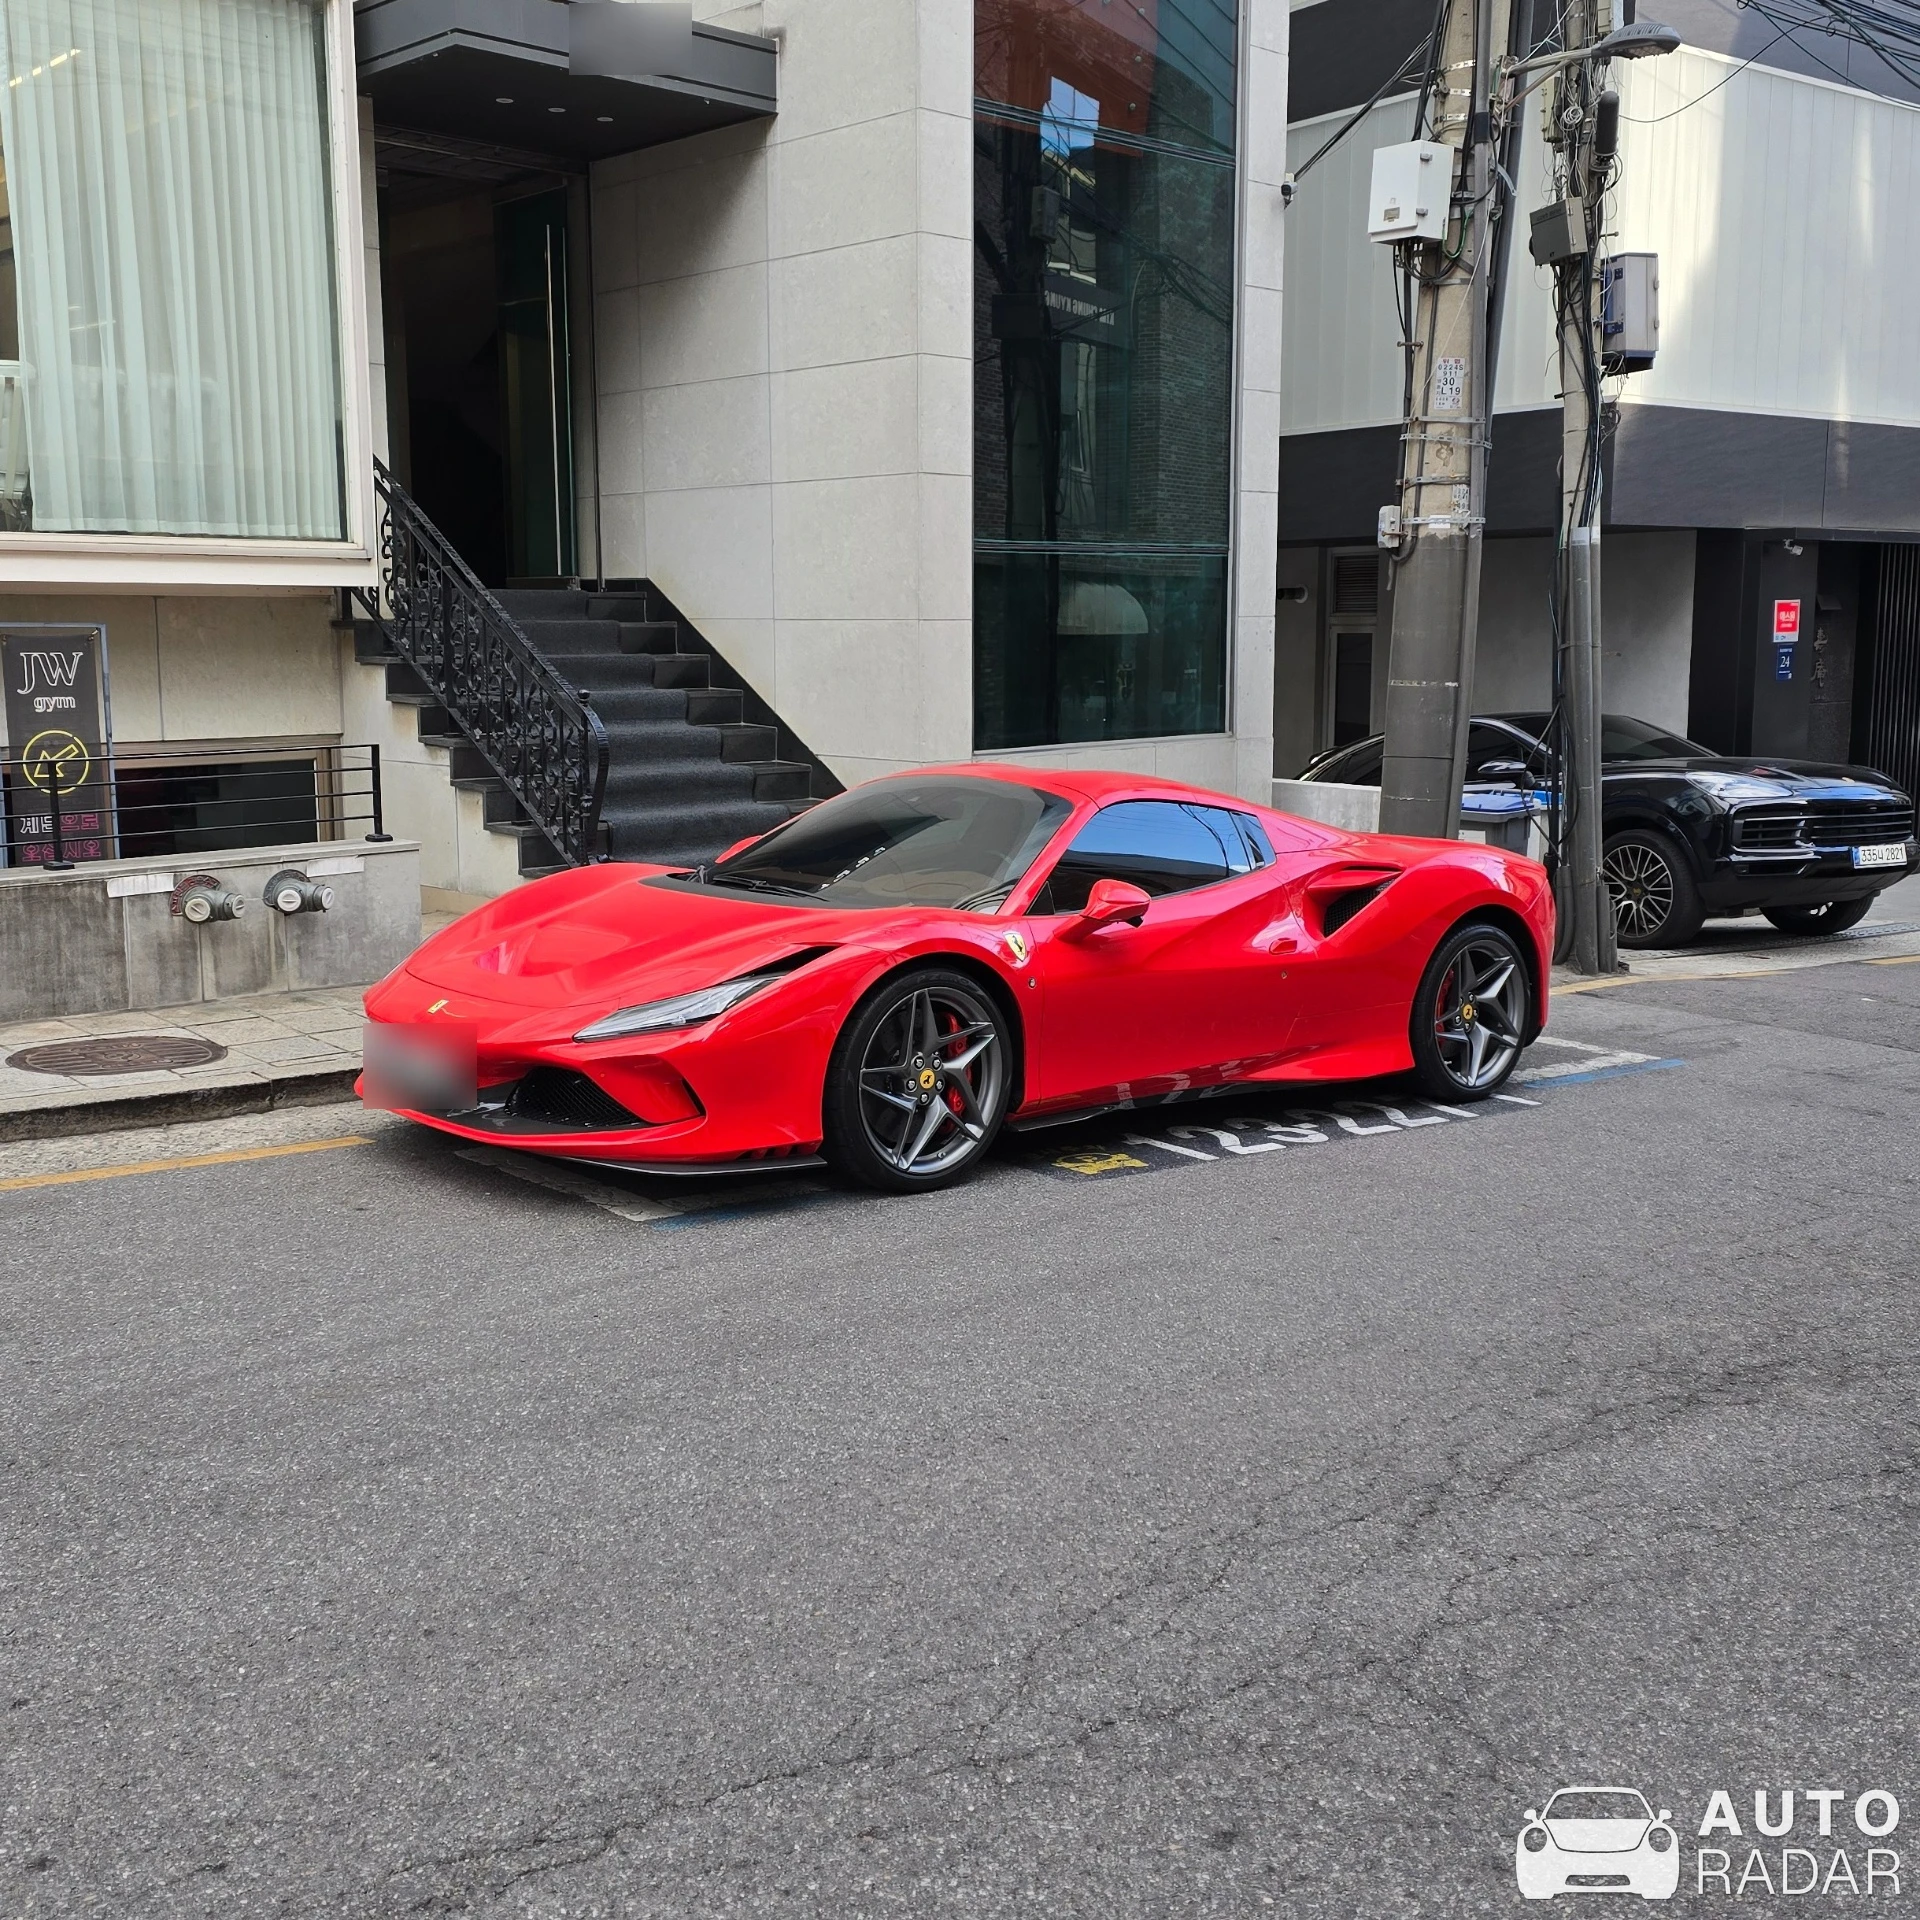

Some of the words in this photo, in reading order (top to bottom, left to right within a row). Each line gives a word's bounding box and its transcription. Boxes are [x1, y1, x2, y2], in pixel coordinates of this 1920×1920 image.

[1437, 363, 1464, 371] 0224S
[1442, 377, 1455, 386] 30
[1441, 386, 1461, 396] L19
[1779, 655, 1790, 668] 24
[17, 651, 84, 695] JW
[33, 695, 76, 713] gym
[1885, 846, 1904, 861] 2821
